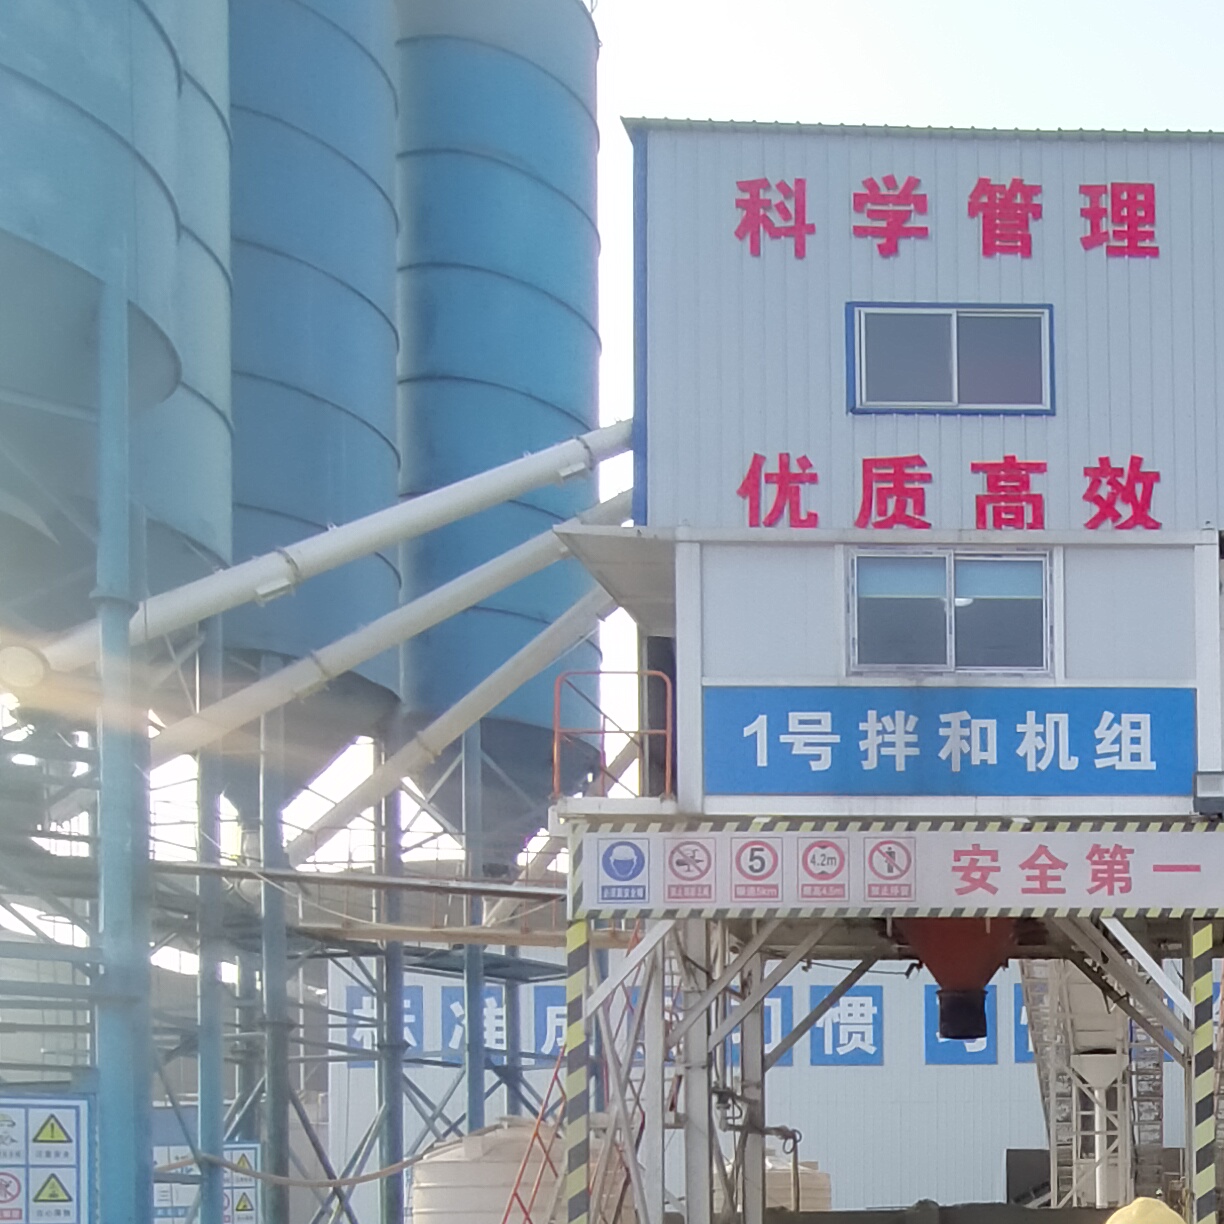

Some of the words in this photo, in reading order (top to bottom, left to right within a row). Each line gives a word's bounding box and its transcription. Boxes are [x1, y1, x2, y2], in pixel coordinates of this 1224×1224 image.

[735, 175, 1160, 260] 科学管理
[737, 453, 1163, 530] 优质高效
[743, 710, 1157, 773] 1号拌和机组
[749, 847, 766, 874] 5
[810, 854, 837, 867] 4.2m
[952, 843, 1202, 897] 安全第一
